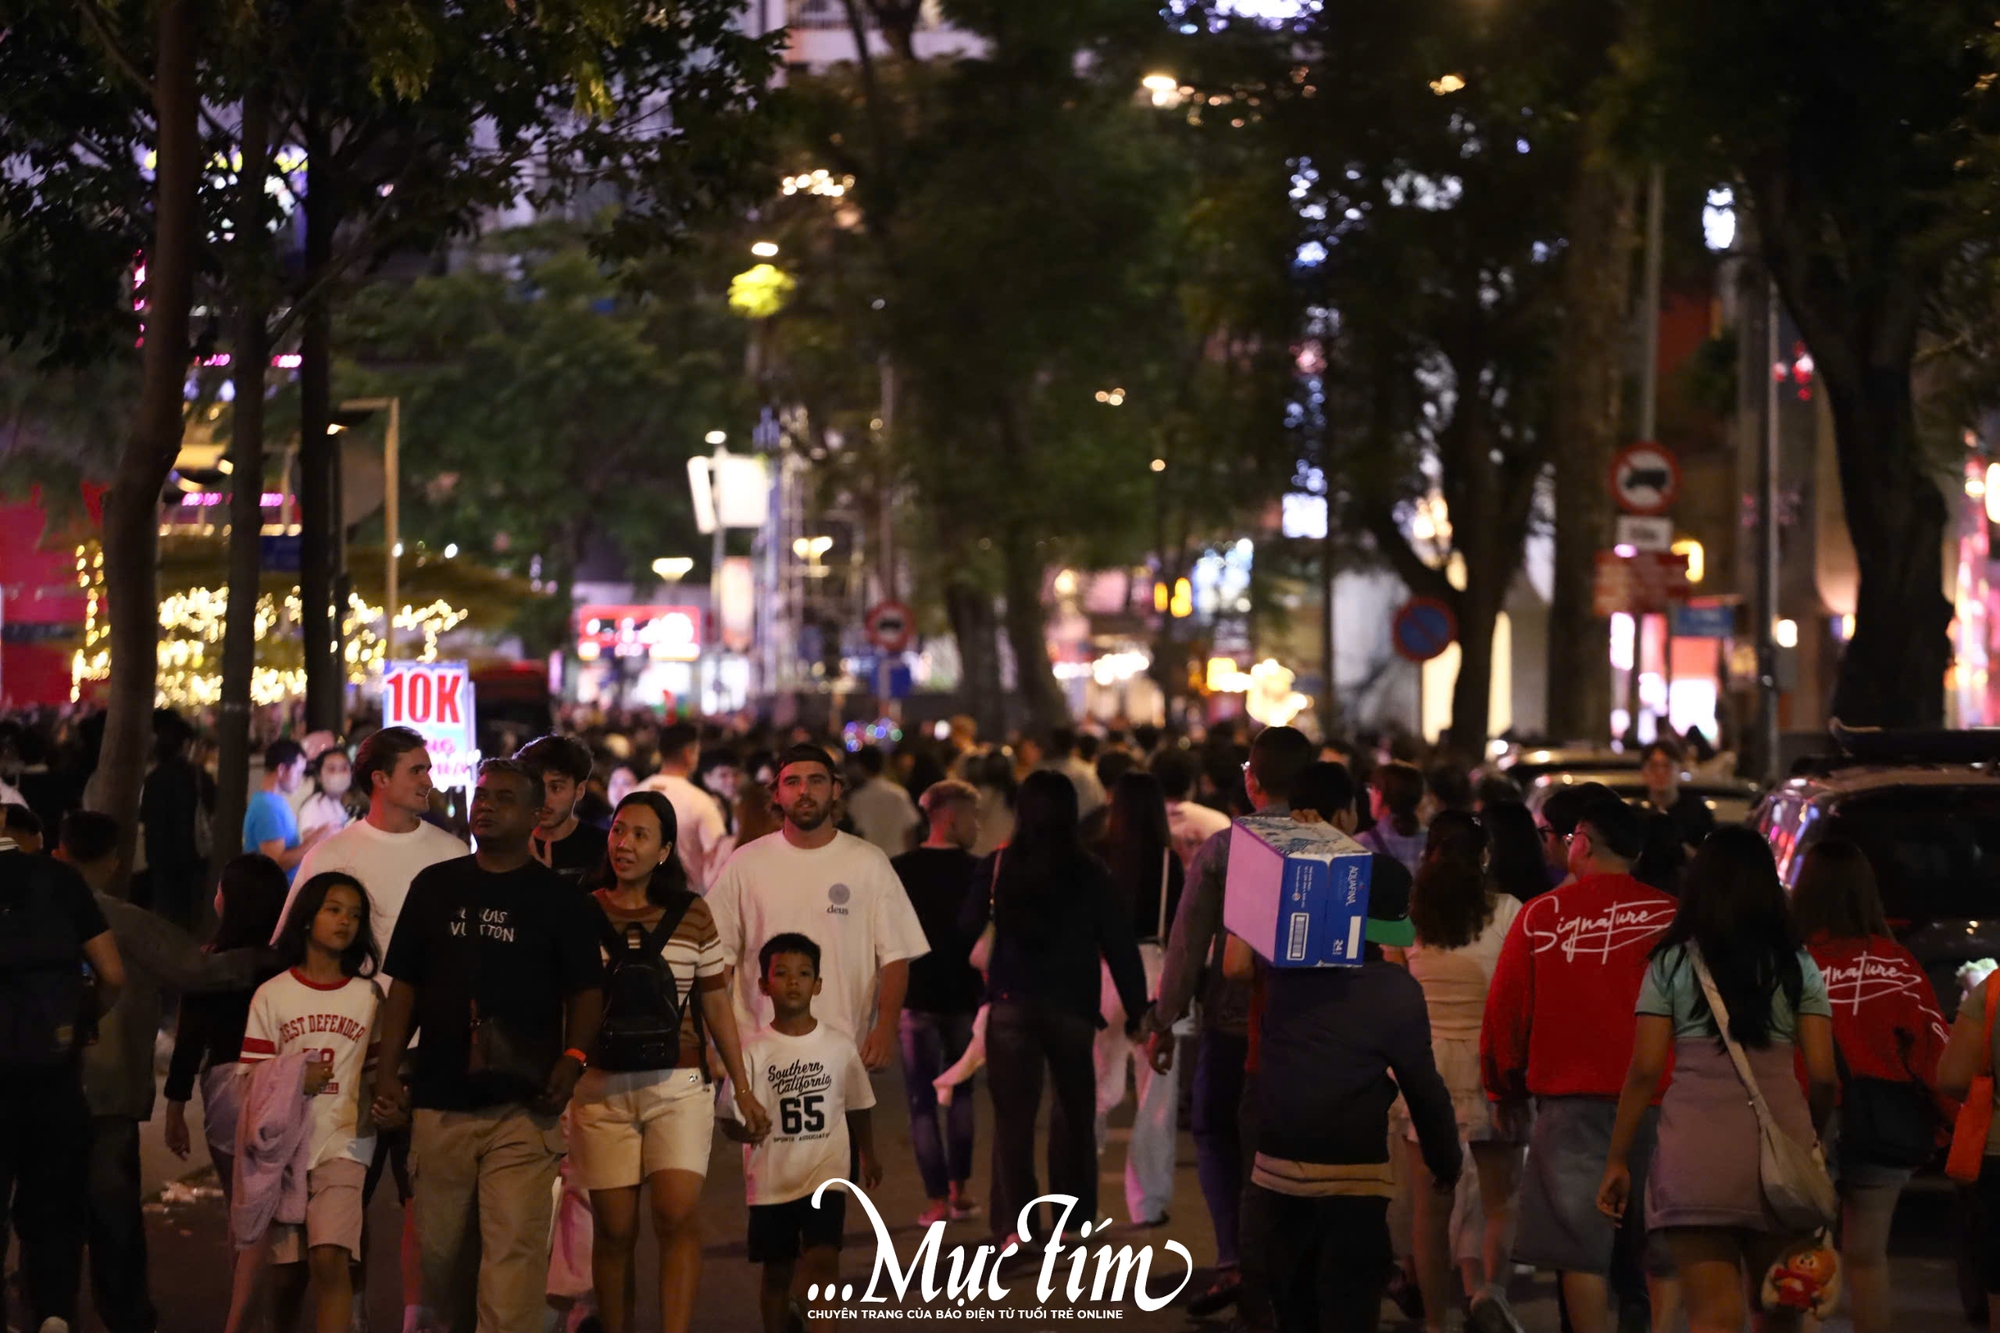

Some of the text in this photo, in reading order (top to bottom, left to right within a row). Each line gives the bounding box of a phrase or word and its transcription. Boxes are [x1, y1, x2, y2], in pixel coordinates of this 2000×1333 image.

[387, 672, 462, 723] 10K
[460, 908, 508, 923] LUIS
[826, 904, 849, 915] deus
[1523, 895, 1677, 965] Signature
[308, 1013, 366, 1043] DEFENDER
[767, 1058, 824, 1082] Southern
[772, 1073, 832, 1098] California
[780, 1095, 825, 1135] 65
